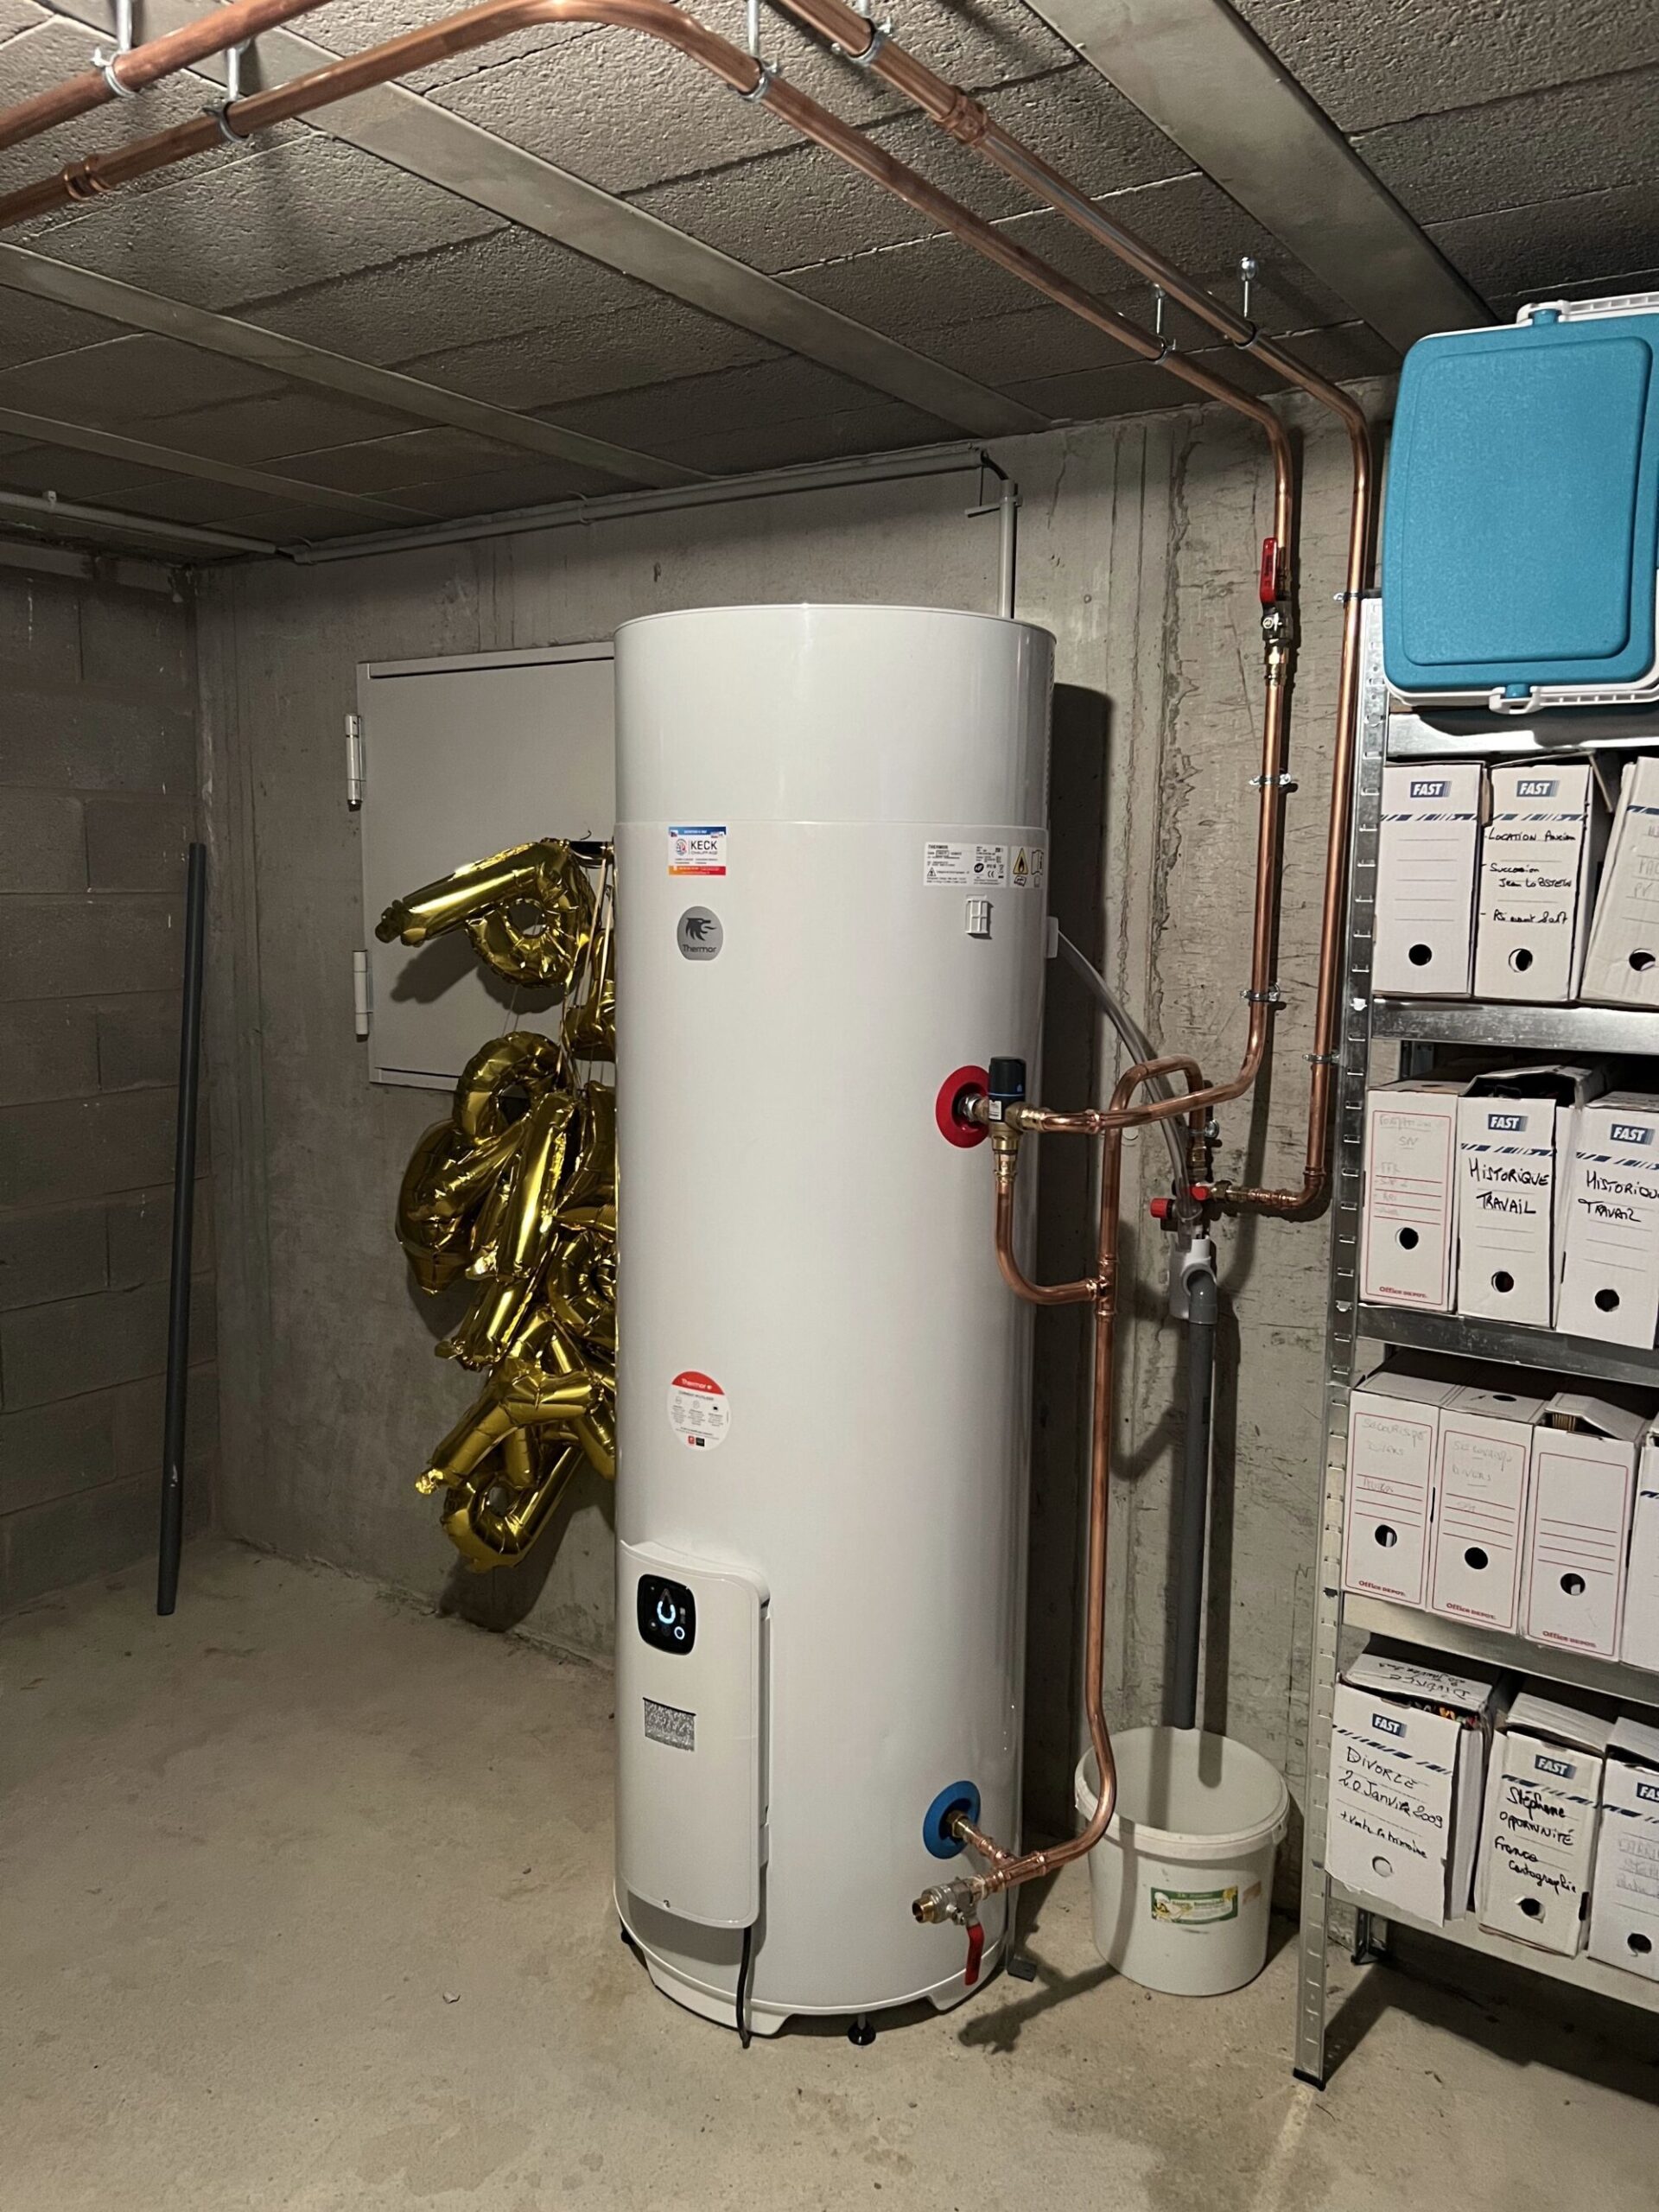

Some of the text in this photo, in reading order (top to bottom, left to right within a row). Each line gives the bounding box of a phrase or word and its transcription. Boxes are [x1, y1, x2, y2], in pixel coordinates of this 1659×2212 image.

[1413, 783, 1443, 795] FAST
[1519, 782, 1550, 795] FAST
[691, 841, 717, 850] KECK
[683, 944, 716, 953] Thermor
[1491, 1116, 1519, 1129] FAST
[1613, 1126, 1645, 1141] FAST
[1358, 1580, 1382, 1591] Office
[1446, 1602, 1470, 1613] Office
[1542, 1630, 1568, 1642] Office
[1374, 1716, 1400, 1733] FAST
[1538, 1758, 1568, 1775] FAST
[1338, 1770, 1361, 1791] 20
[1413, 1805, 1443, 1828] 2009
